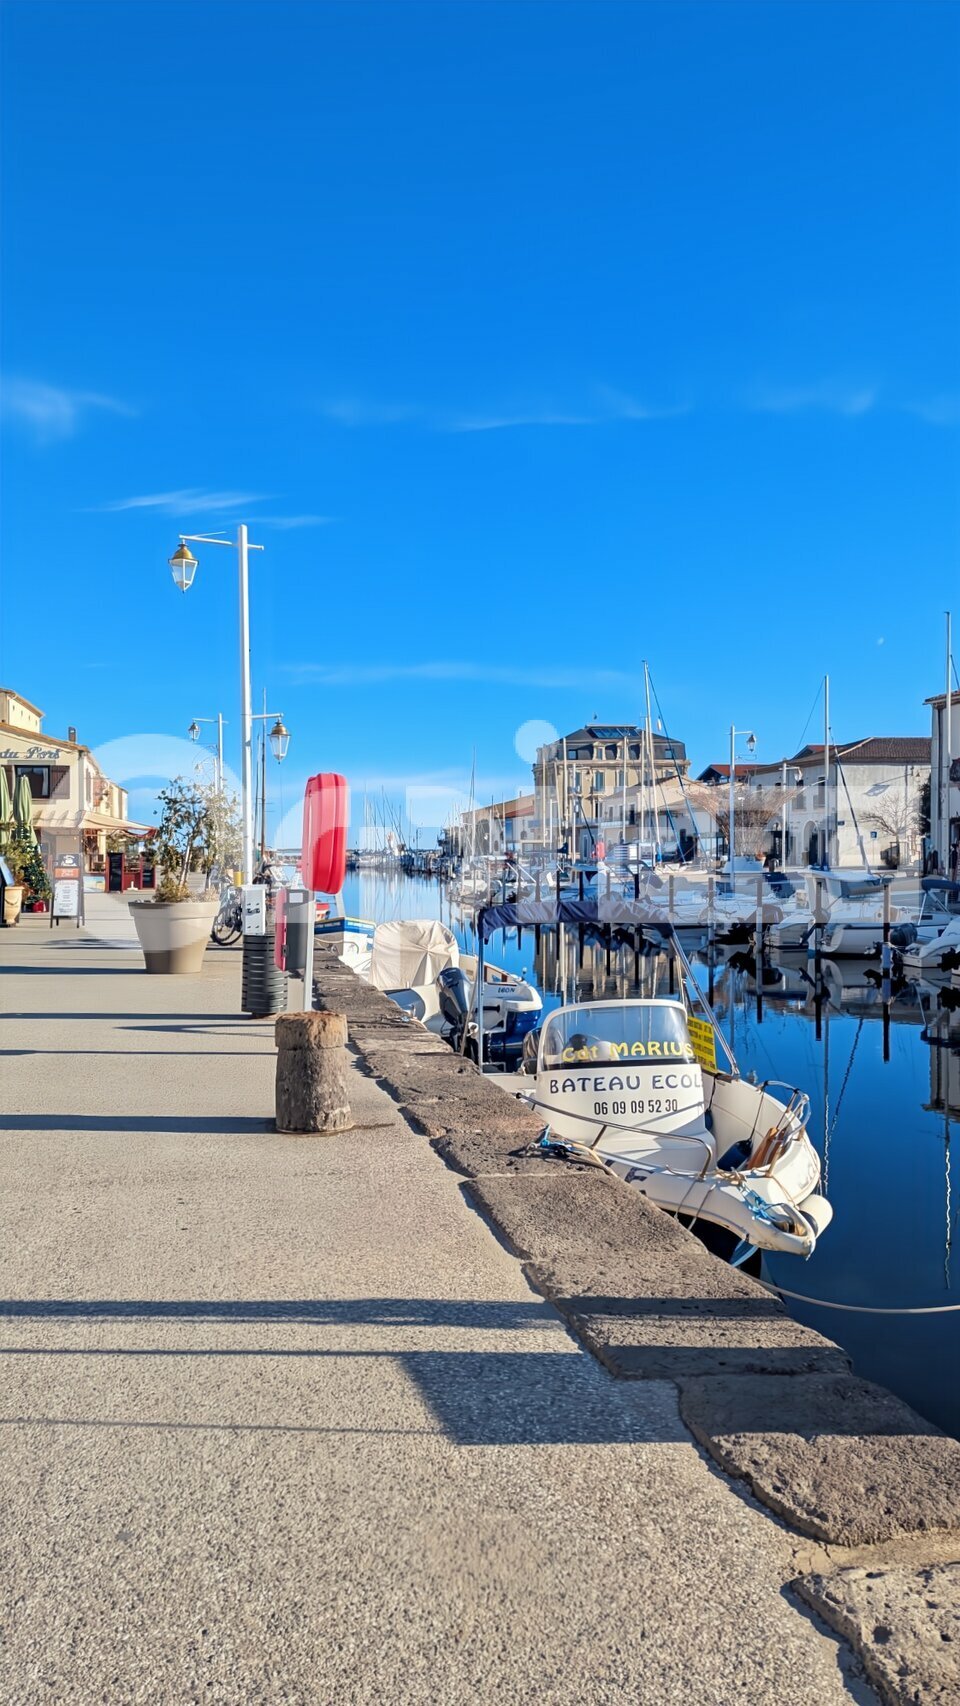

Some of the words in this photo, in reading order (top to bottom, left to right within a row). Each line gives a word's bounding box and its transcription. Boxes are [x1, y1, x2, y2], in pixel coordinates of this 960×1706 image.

[26, 746, 60, 760] Port
[562, 1045, 598, 1062] Cdt
[609, 1041, 695, 1058] MARIUS
[550, 1075, 641, 1094] BATEAU
[652, 1074, 704, 1090] ECOL
[594, 1101, 608, 1116] 06
[612, 1101, 626, 1115] 09
[631, 1100, 645, 1114] 09
[648, 1099, 662, 1113] 52
[665, 1099, 678, 1112] 30
